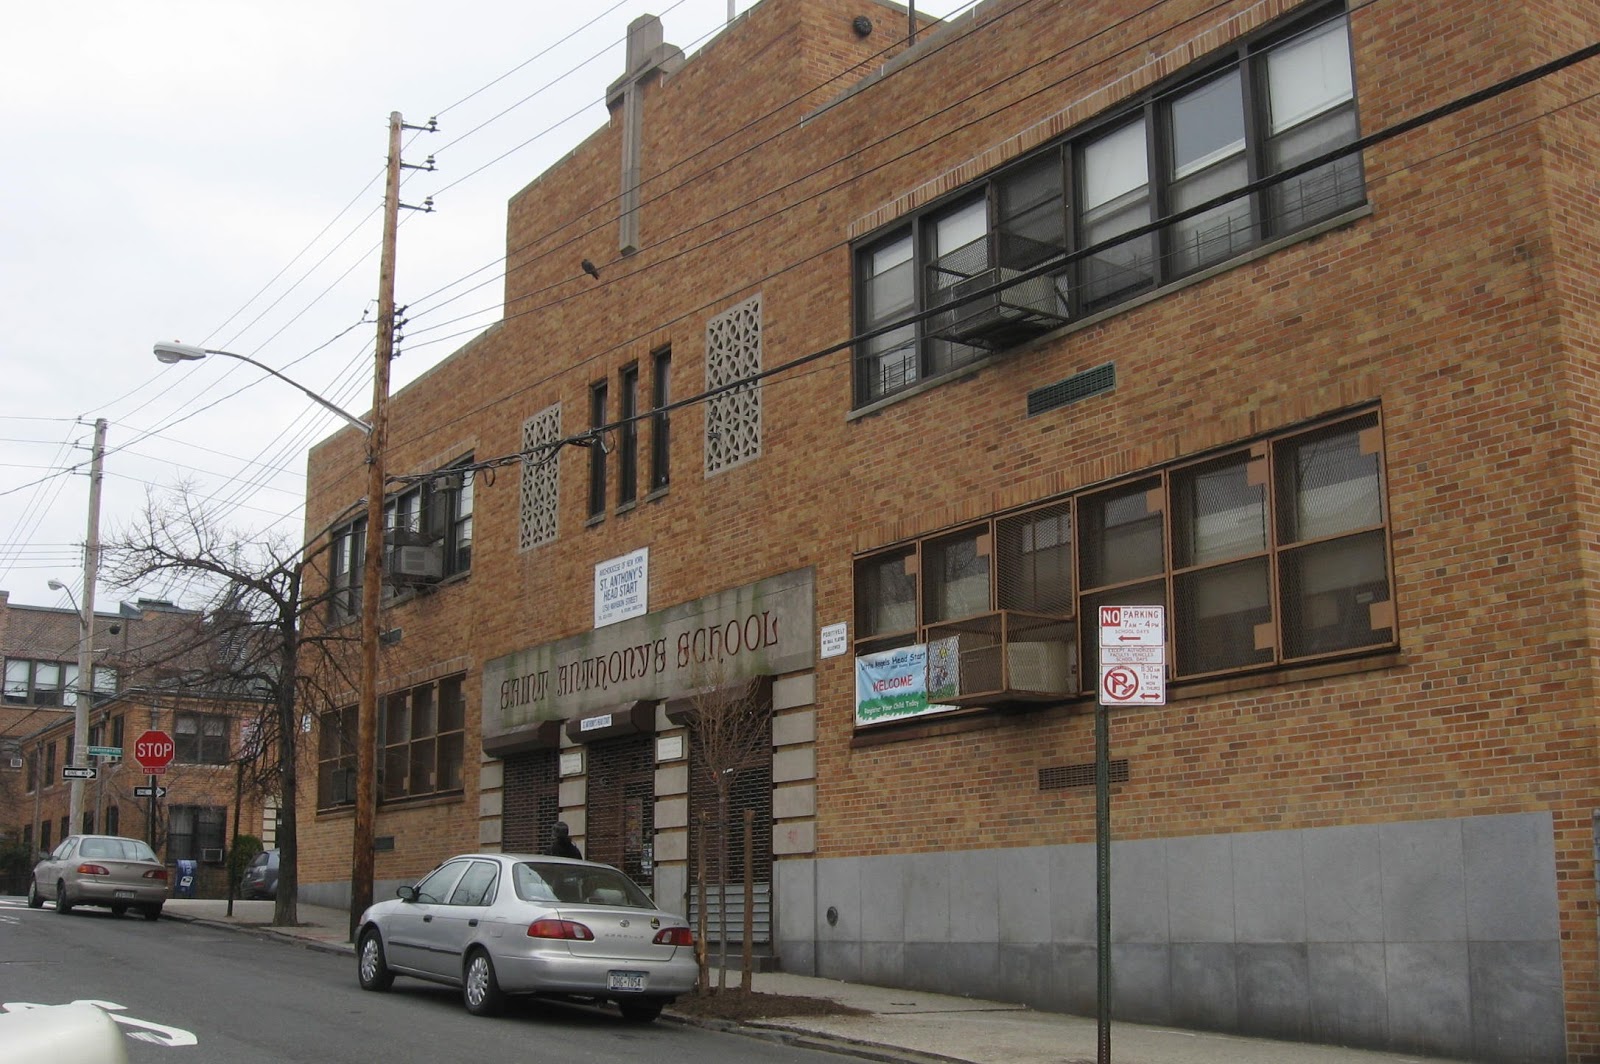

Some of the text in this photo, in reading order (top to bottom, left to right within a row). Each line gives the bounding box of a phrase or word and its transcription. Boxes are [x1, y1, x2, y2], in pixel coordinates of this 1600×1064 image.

[610, 566, 642, 588] ANTHONY'S
[603, 580, 638, 602] HEAD START
[1103, 610, 1159, 624] NO PARKING
[500, 610, 779, 711] SAINT ANTHONY'S SCHOOL
[892, 655, 908, 664] Head
[910, 652, 926, 662] Start
[872, 674, 913, 692] WELCOME
[906, 699, 919, 707] Today
[137, 743, 172, 757] STOP
